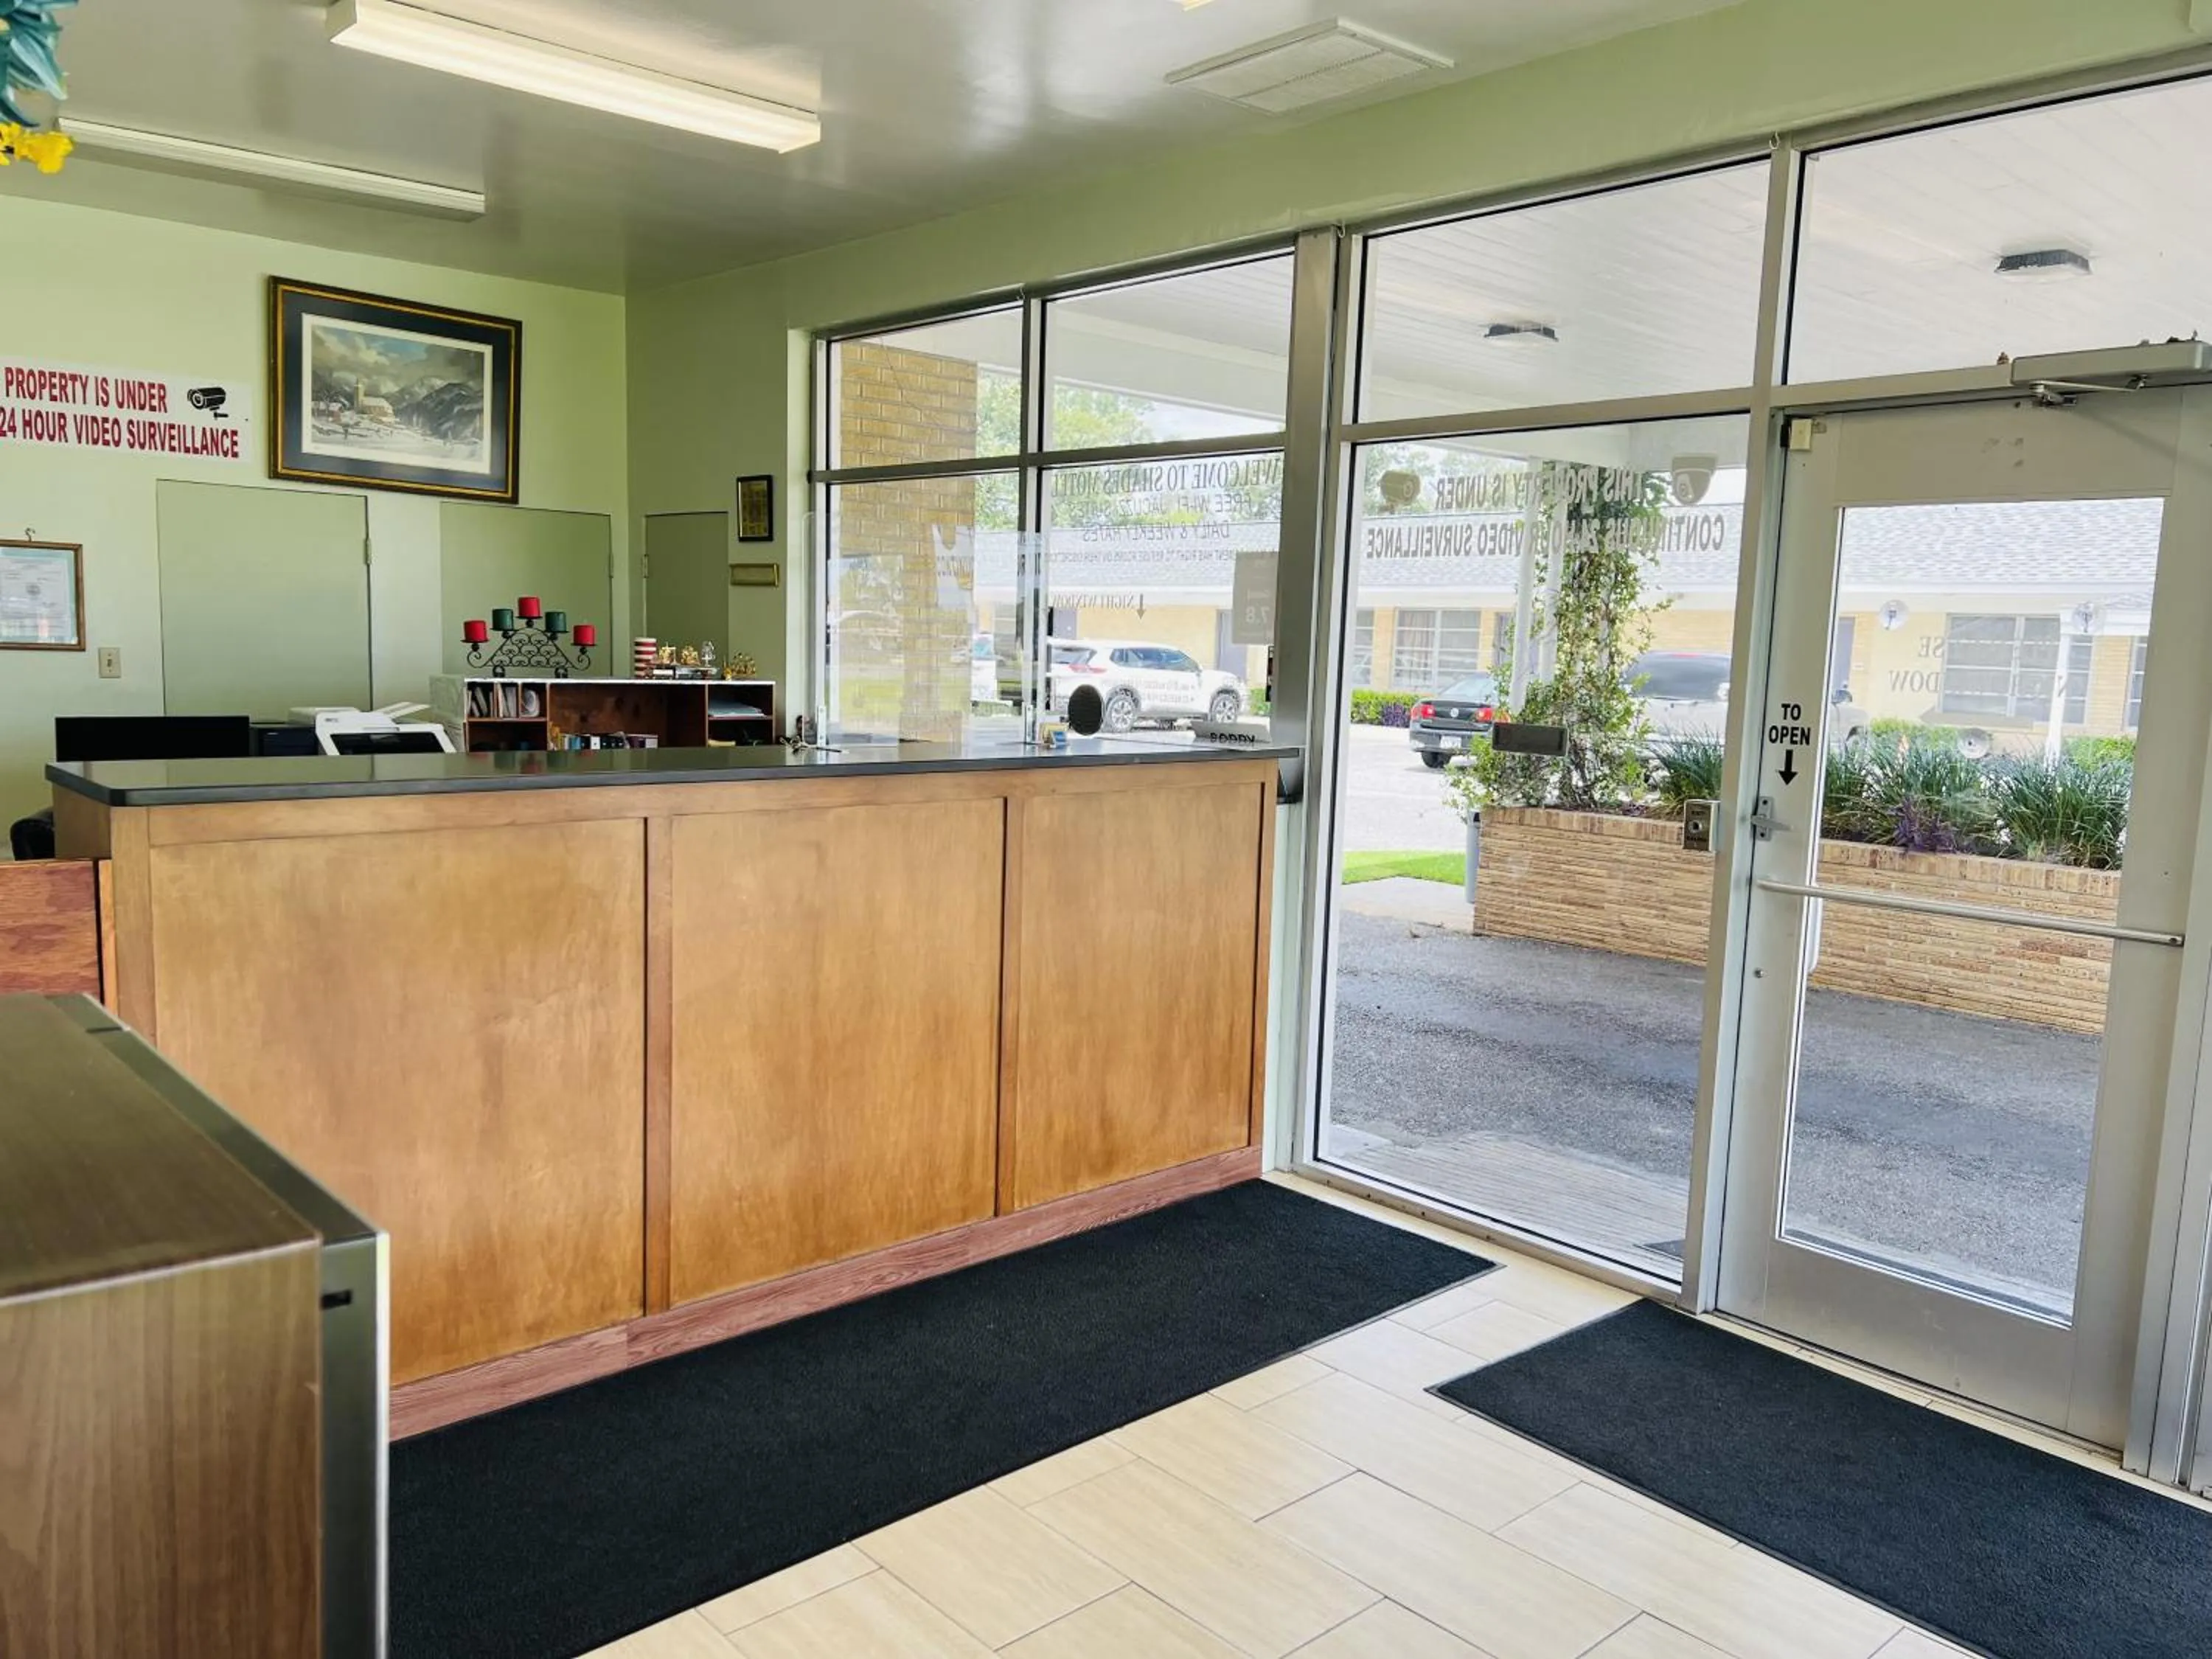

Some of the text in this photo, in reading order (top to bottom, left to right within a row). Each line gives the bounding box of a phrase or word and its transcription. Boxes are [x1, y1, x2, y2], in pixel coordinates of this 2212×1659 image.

[4, 366, 167, 413] PROPERTY IS UNDER
[0, 406, 240, 458] 24 HOUR VIDEO SURVEILLANCE
[1781, 703, 1801, 720] TO
[1768, 726, 1811, 745] OPEN
